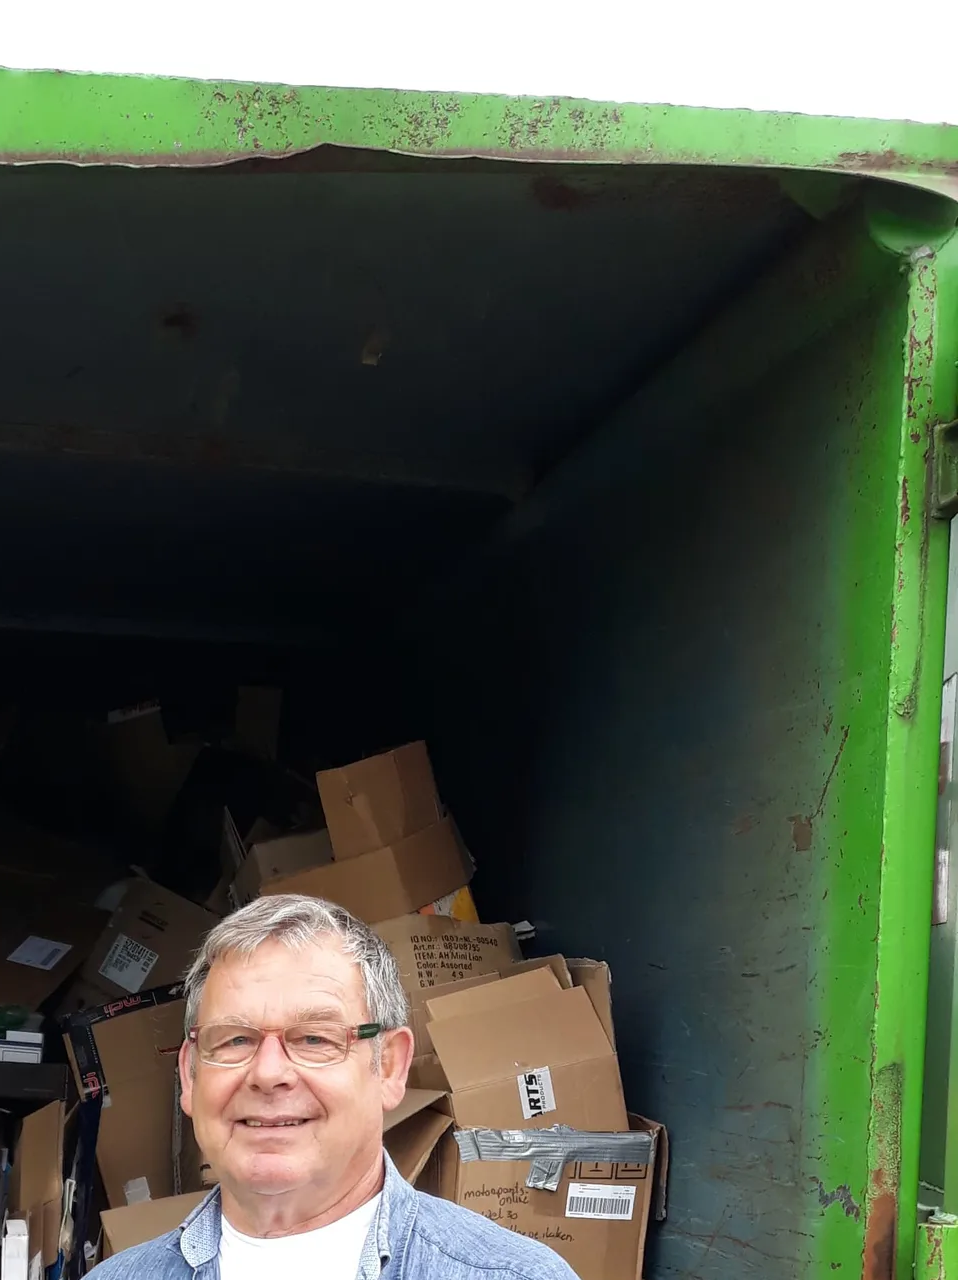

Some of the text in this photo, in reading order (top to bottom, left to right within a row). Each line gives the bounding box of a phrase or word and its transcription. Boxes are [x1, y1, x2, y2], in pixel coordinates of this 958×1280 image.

[438, 952, 450, 960] AH
[451, 952, 468, 961] Mini
[416, 961, 473, 970] Color: Assorted
